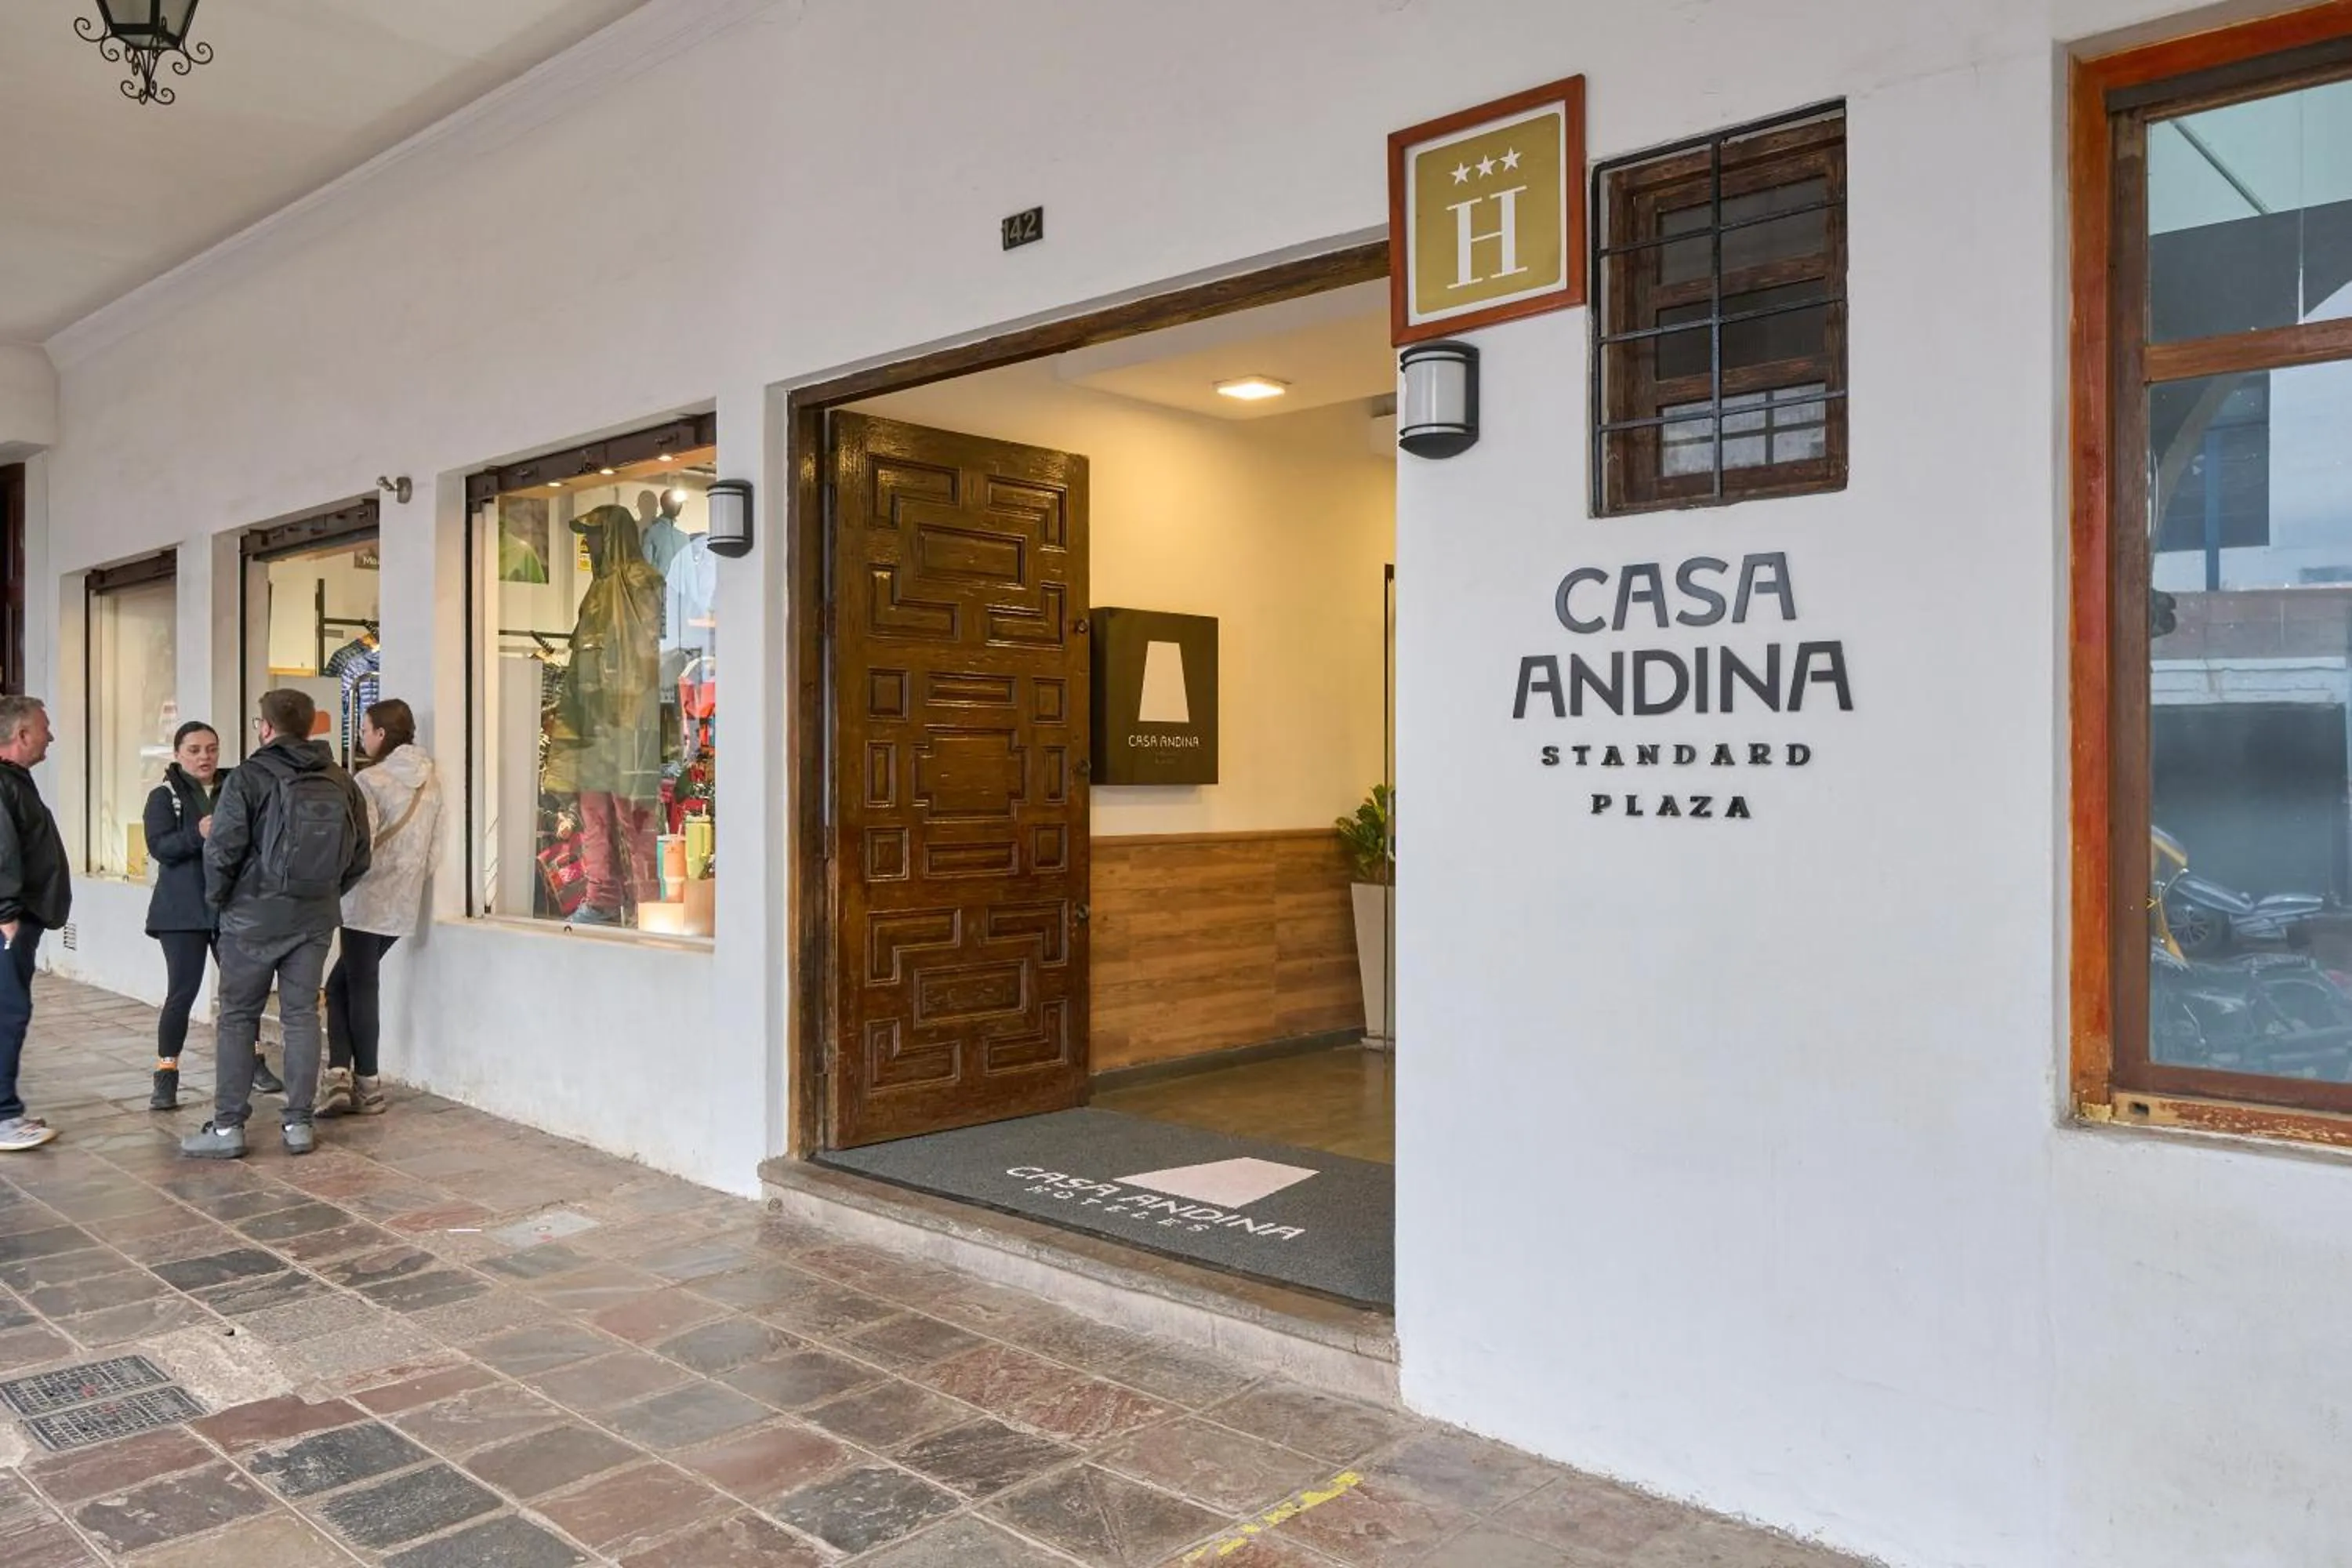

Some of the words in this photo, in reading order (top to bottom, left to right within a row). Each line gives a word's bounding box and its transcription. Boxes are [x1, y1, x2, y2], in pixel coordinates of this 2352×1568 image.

[1446, 185, 1528, 289] H
[1555, 551, 1797, 634] CASA
[1512, 641, 1854, 719] ANDINA
[1128, 735, 1158, 747] CASA
[1160, 735, 1200, 747] ANDINA
[1541, 743, 1813, 767] STANDARD
[1590, 793, 1751, 818] PLAZA
[1006, 1166, 1122, 1197] CASA
[1116, 1194, 1306, 1241] ANDINA
